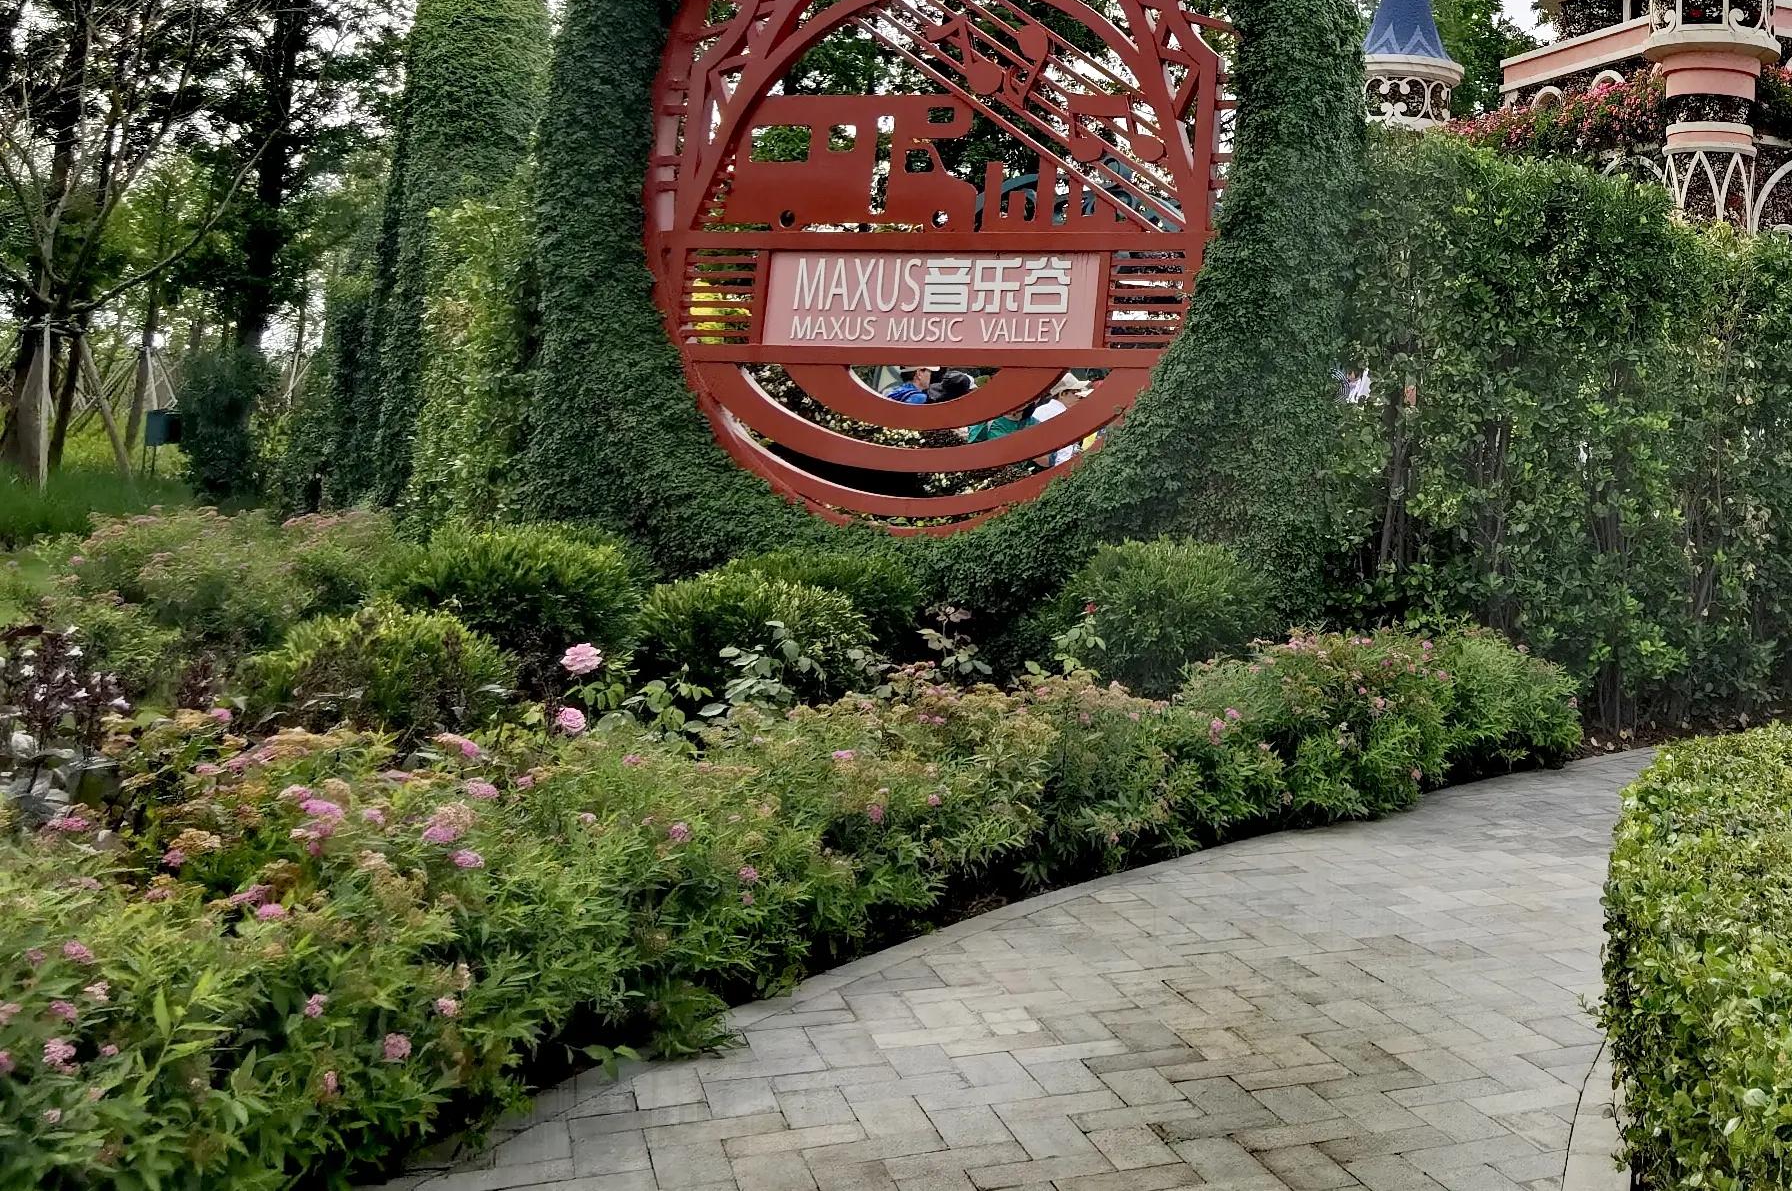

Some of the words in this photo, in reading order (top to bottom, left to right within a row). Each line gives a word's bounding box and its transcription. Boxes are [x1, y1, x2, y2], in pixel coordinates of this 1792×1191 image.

[792, 256, 1072, 314] MAXUS音乐谷
[790, 315, 878, 341] MAXUS
[886, 316, 964, 342] MUSIC
[980, 317, 1068, 343] VALLEY
